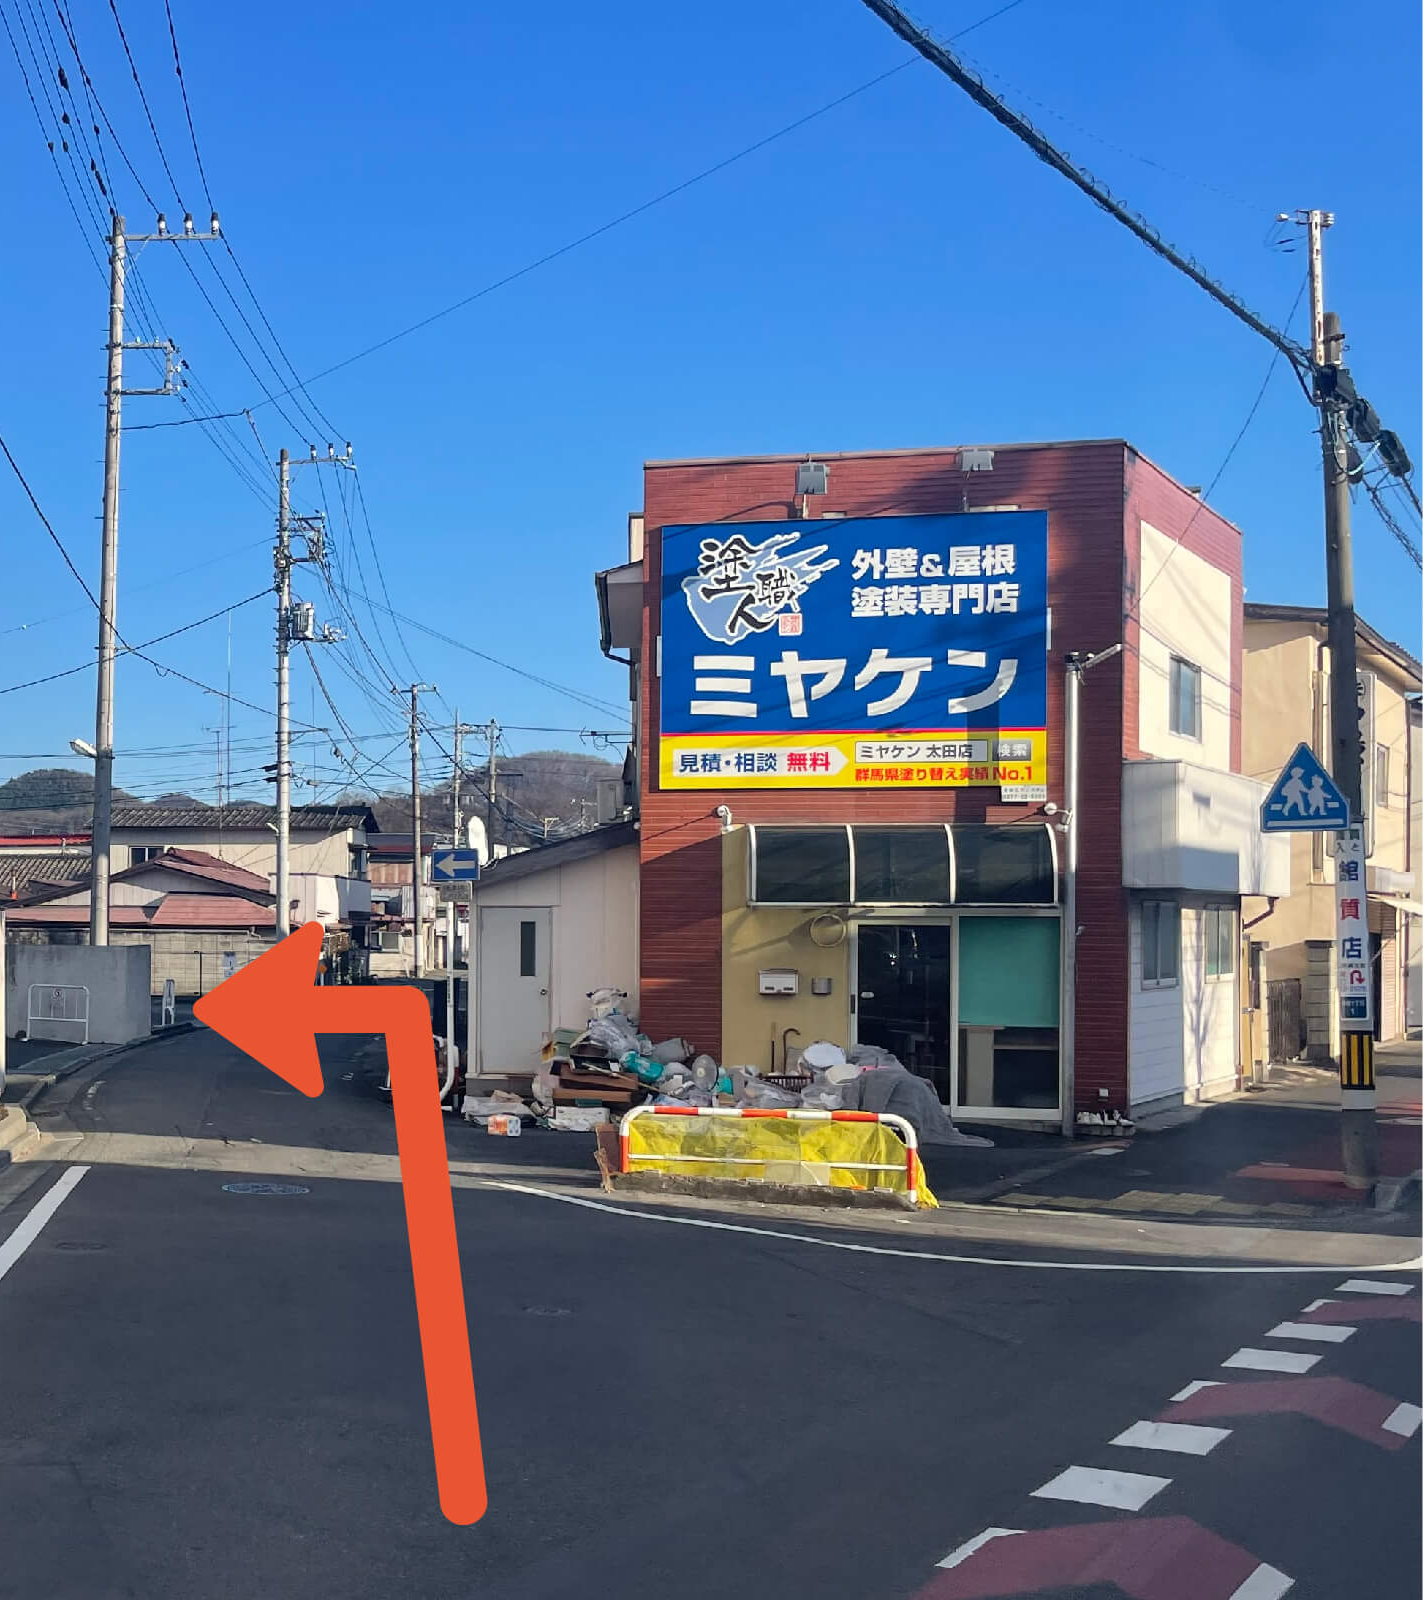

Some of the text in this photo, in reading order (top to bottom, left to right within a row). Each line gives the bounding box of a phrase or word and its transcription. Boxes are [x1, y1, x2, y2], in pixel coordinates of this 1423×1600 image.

[851, 544, 1017, 580] 外壁&屋根
[851, 582, 1020, 618] 塗装専門店
[689, 648, 1019, 718] ミヤケン
[786, 751, 831, 773] 無料
[860, 744, 974, 759] ミヤケン 太田店
[997, 743, 1028, 758] 検索
